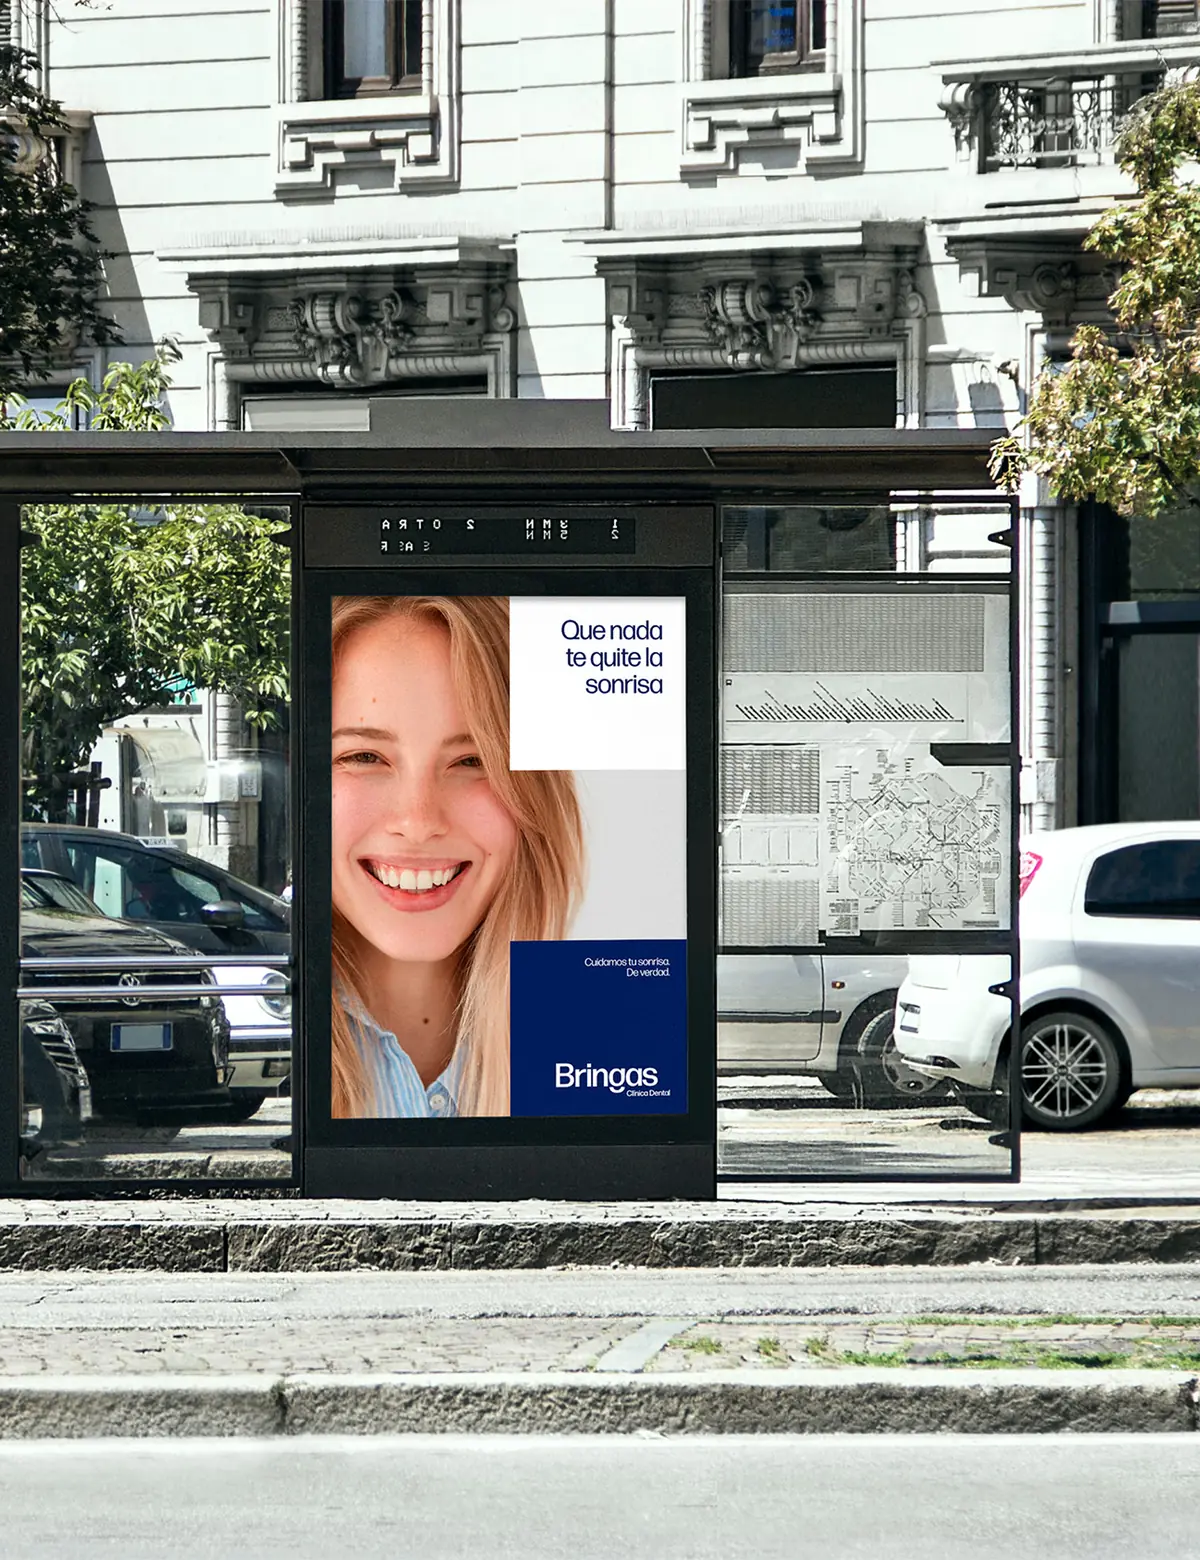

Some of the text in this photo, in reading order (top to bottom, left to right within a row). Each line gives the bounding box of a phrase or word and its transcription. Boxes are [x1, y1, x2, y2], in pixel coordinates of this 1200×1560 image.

[561, 620, 663, 640] Que nada
[566, 647, 663, 671] te quite la
[586, 675, 663, 694] sonrisa
[584, 957, 671, 967] Cuidamos tu sonrisa.
[626, 967, 671, 977] De verdad.
[555, 1063, 659, 1094] Bringas
[649, 1089, 671, 1097] Dental
